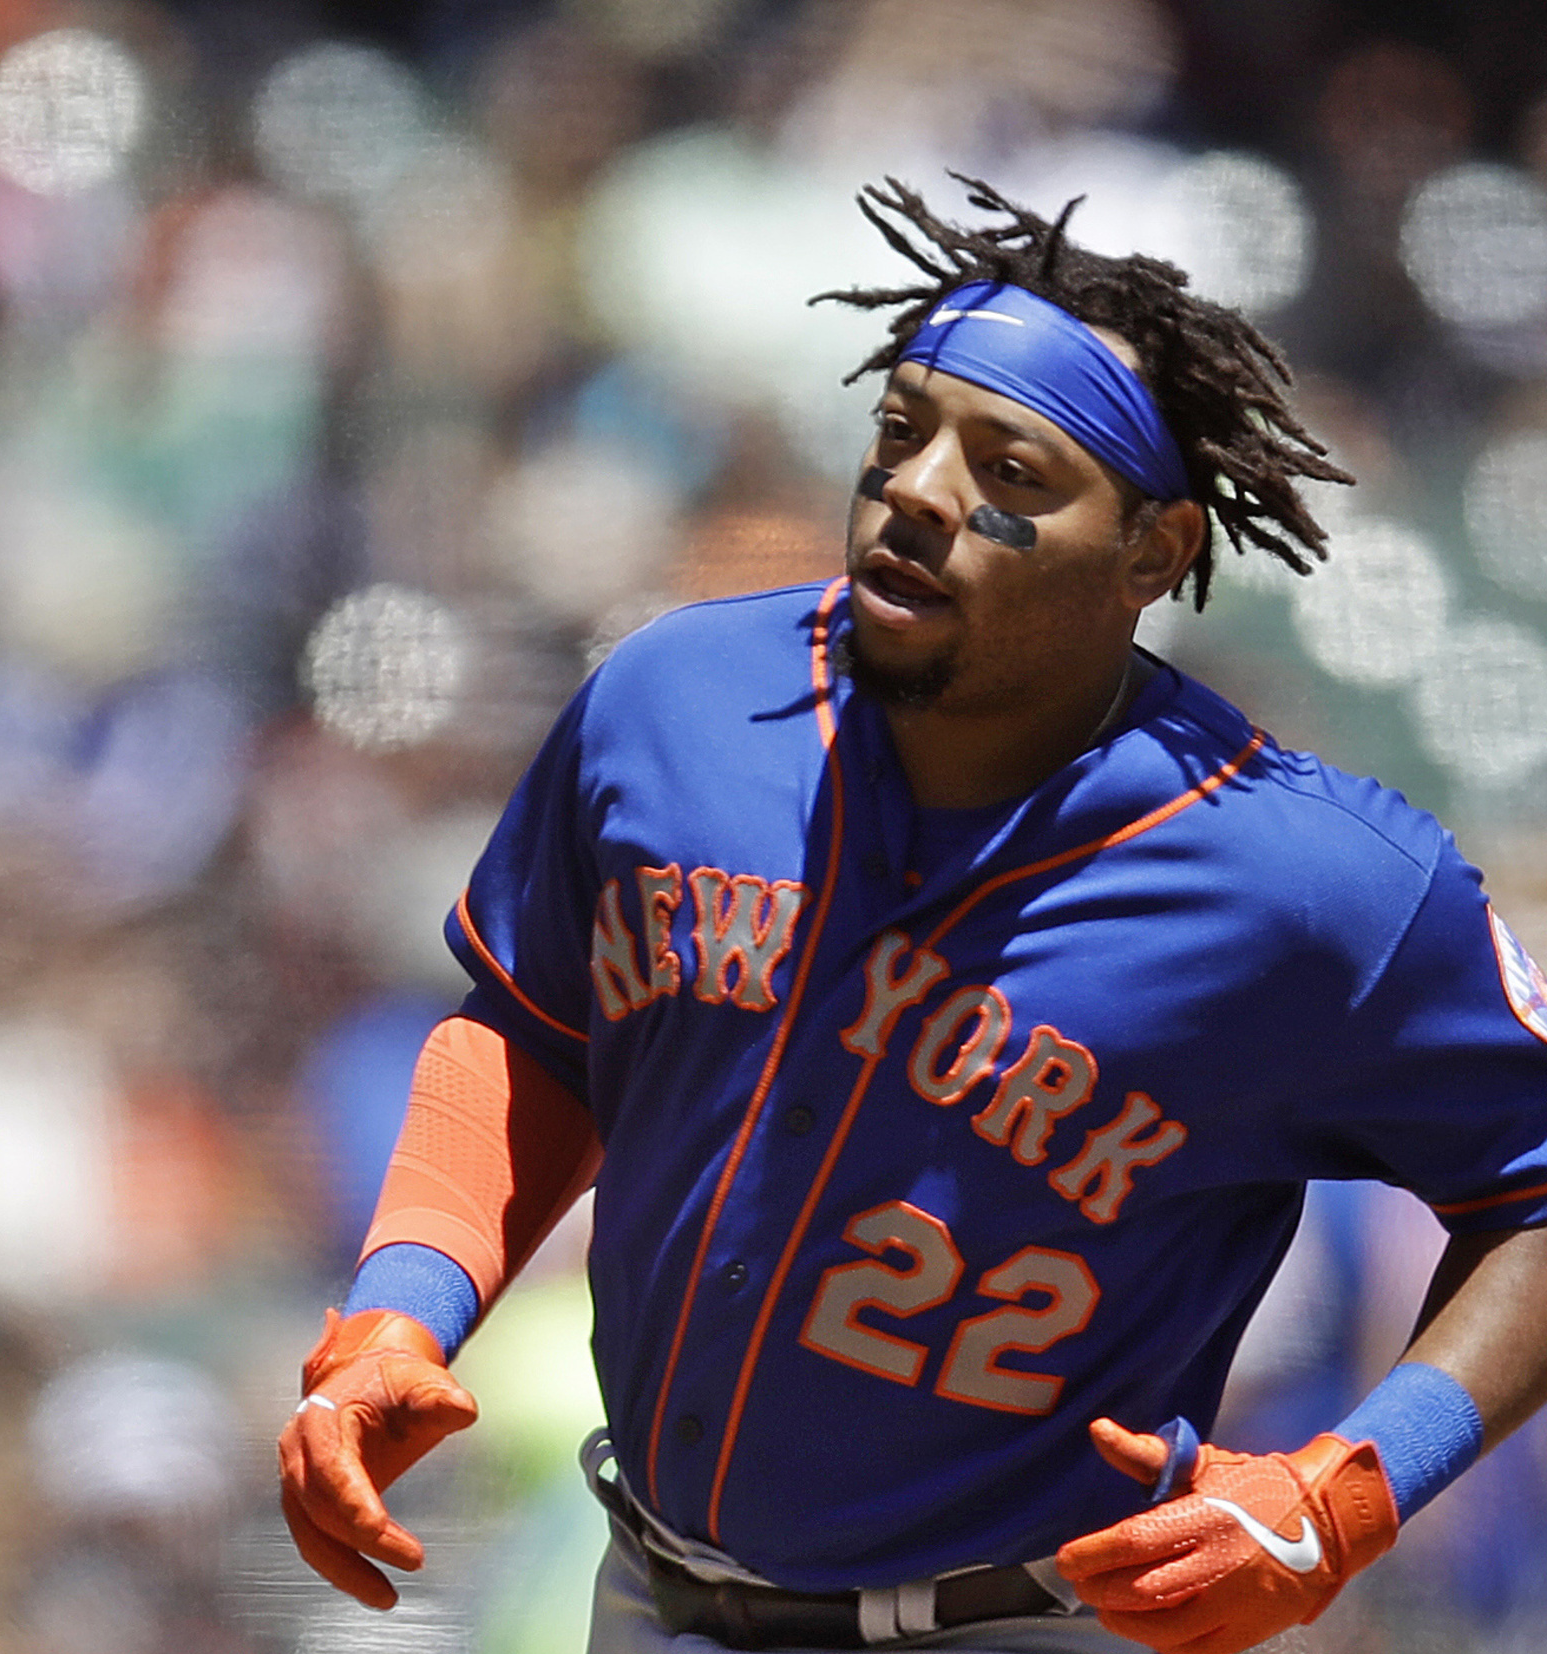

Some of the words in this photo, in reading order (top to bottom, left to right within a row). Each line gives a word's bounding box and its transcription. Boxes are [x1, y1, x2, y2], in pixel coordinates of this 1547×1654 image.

[590, 862, 813, 1021] NEW
[840, 927, 1188, 1225] YORK
[798, 1200, 1101, 1415] 22
